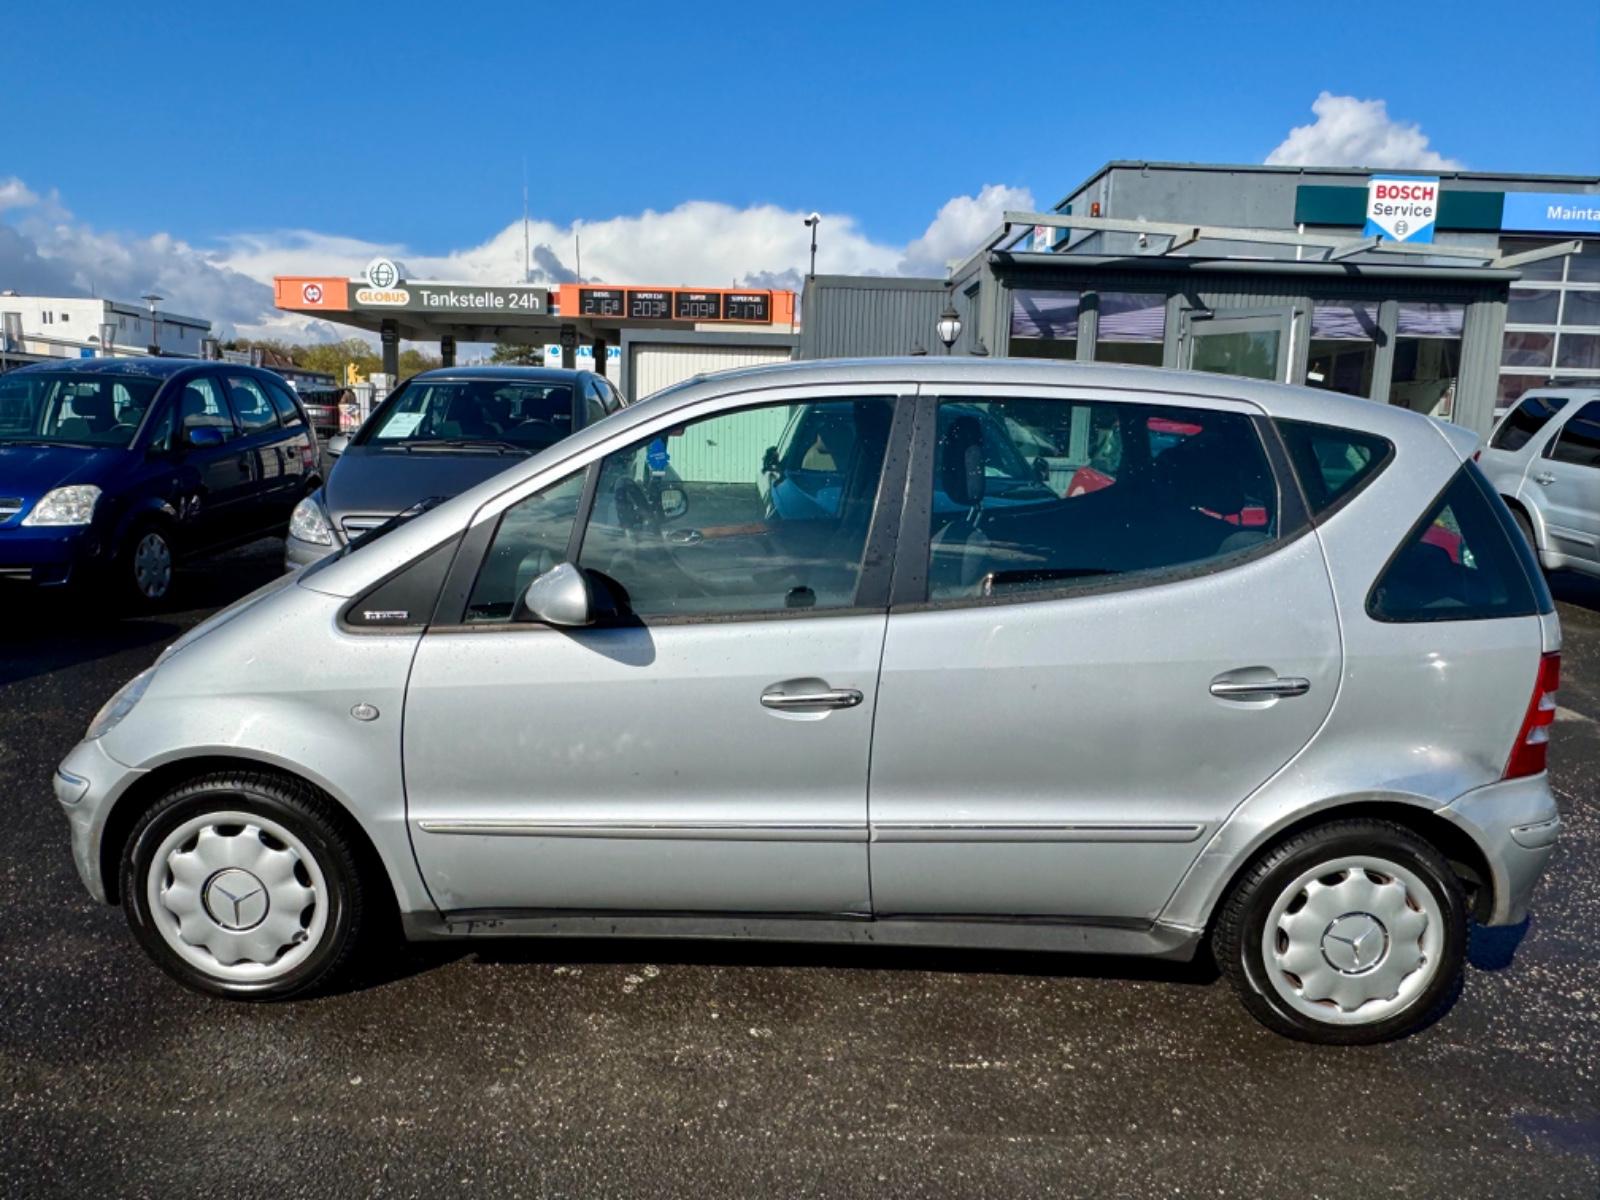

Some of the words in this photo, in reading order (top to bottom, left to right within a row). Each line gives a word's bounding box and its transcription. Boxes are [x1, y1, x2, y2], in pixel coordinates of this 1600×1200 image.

[1375, 184, 1434, 201] BOSCH
[1373, 203, 1433, 218] Service
[359, 291, 407, 302] GLOBUS
[419, 290, 504, 309] Tankstelle
[508, 293, 539, 310] 24h
